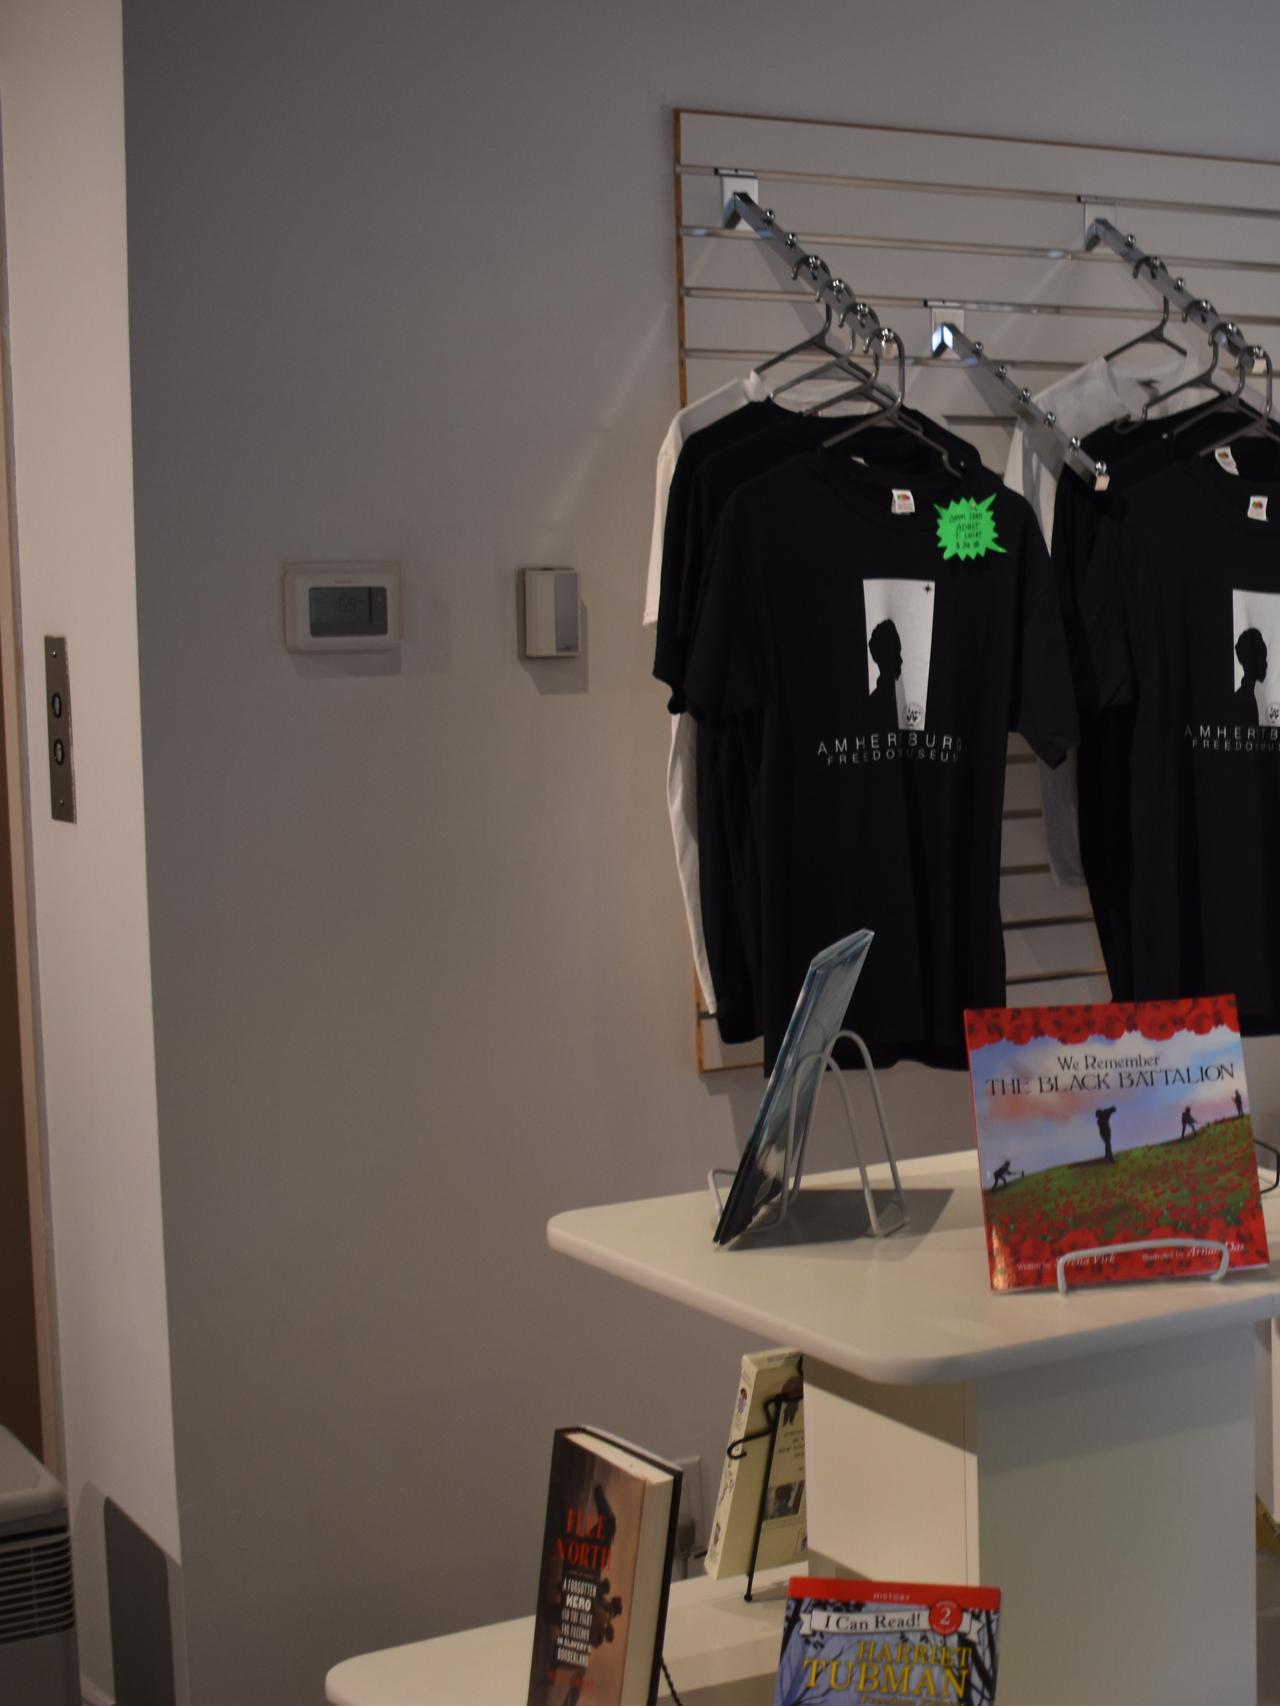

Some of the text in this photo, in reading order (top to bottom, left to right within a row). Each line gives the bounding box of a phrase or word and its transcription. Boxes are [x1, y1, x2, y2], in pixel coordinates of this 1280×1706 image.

[1057, 1053, 1160, 1072] We Remember
[985, 1063, 1236, 1097] THE BLACK BATTALION
[566, 1508, 606, 1540] FLEE
[556, 1536, 612, 1572] NORTH
[566, 1594, 592, 1612] HERO
[940, 1607, 951, 1625] 2
[824, 1615, 830, 1629] I
[834, 1614, 868, 1631] Can
[875, 1613, 922, 1630] Read!
[858, 1639, 973, 1667] HARRIET
[802, 1658, 970, 1699] TUBMAN
